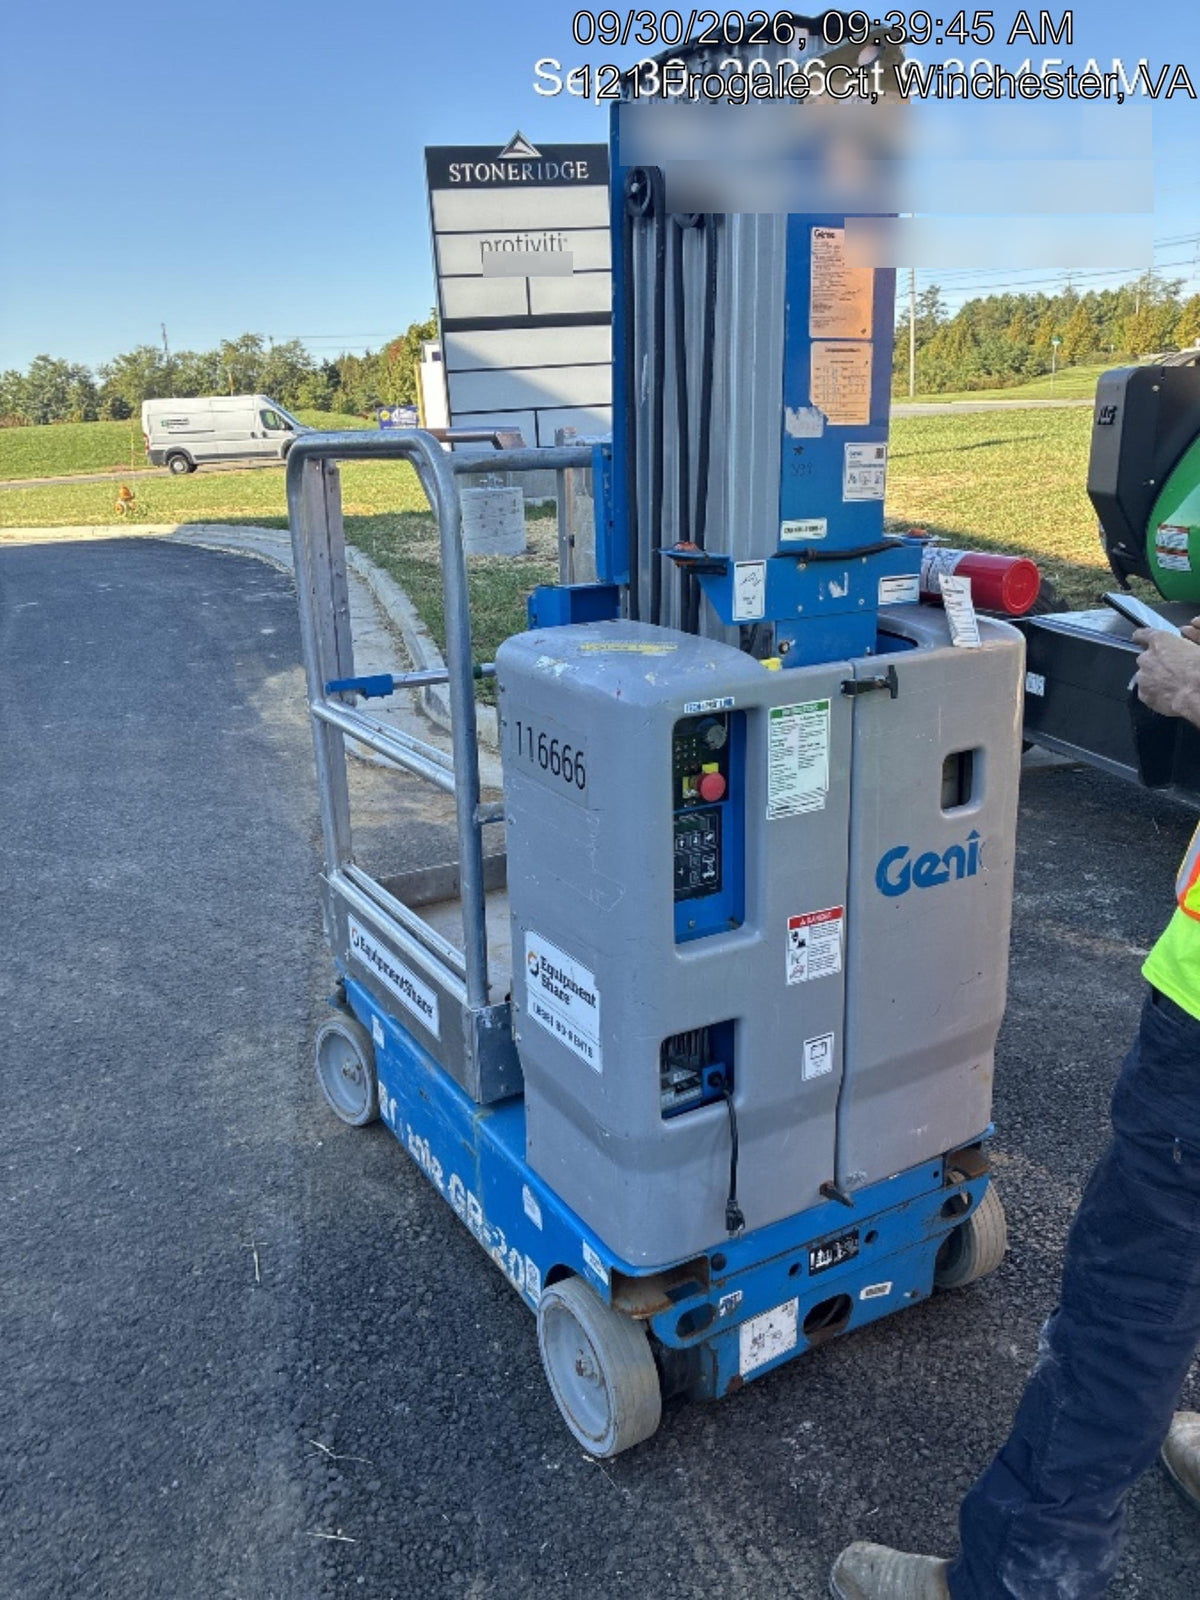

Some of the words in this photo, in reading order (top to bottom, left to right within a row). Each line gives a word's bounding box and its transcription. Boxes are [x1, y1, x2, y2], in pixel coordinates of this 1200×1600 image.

[449, 161, 589, 182] STONERIDGE
[515, 721, 586, 790] 116666
[875, 829, 984, 897] Geni
[540, 955, 597, 1009] Equipment
[541, 972, 572, 1006] Share
